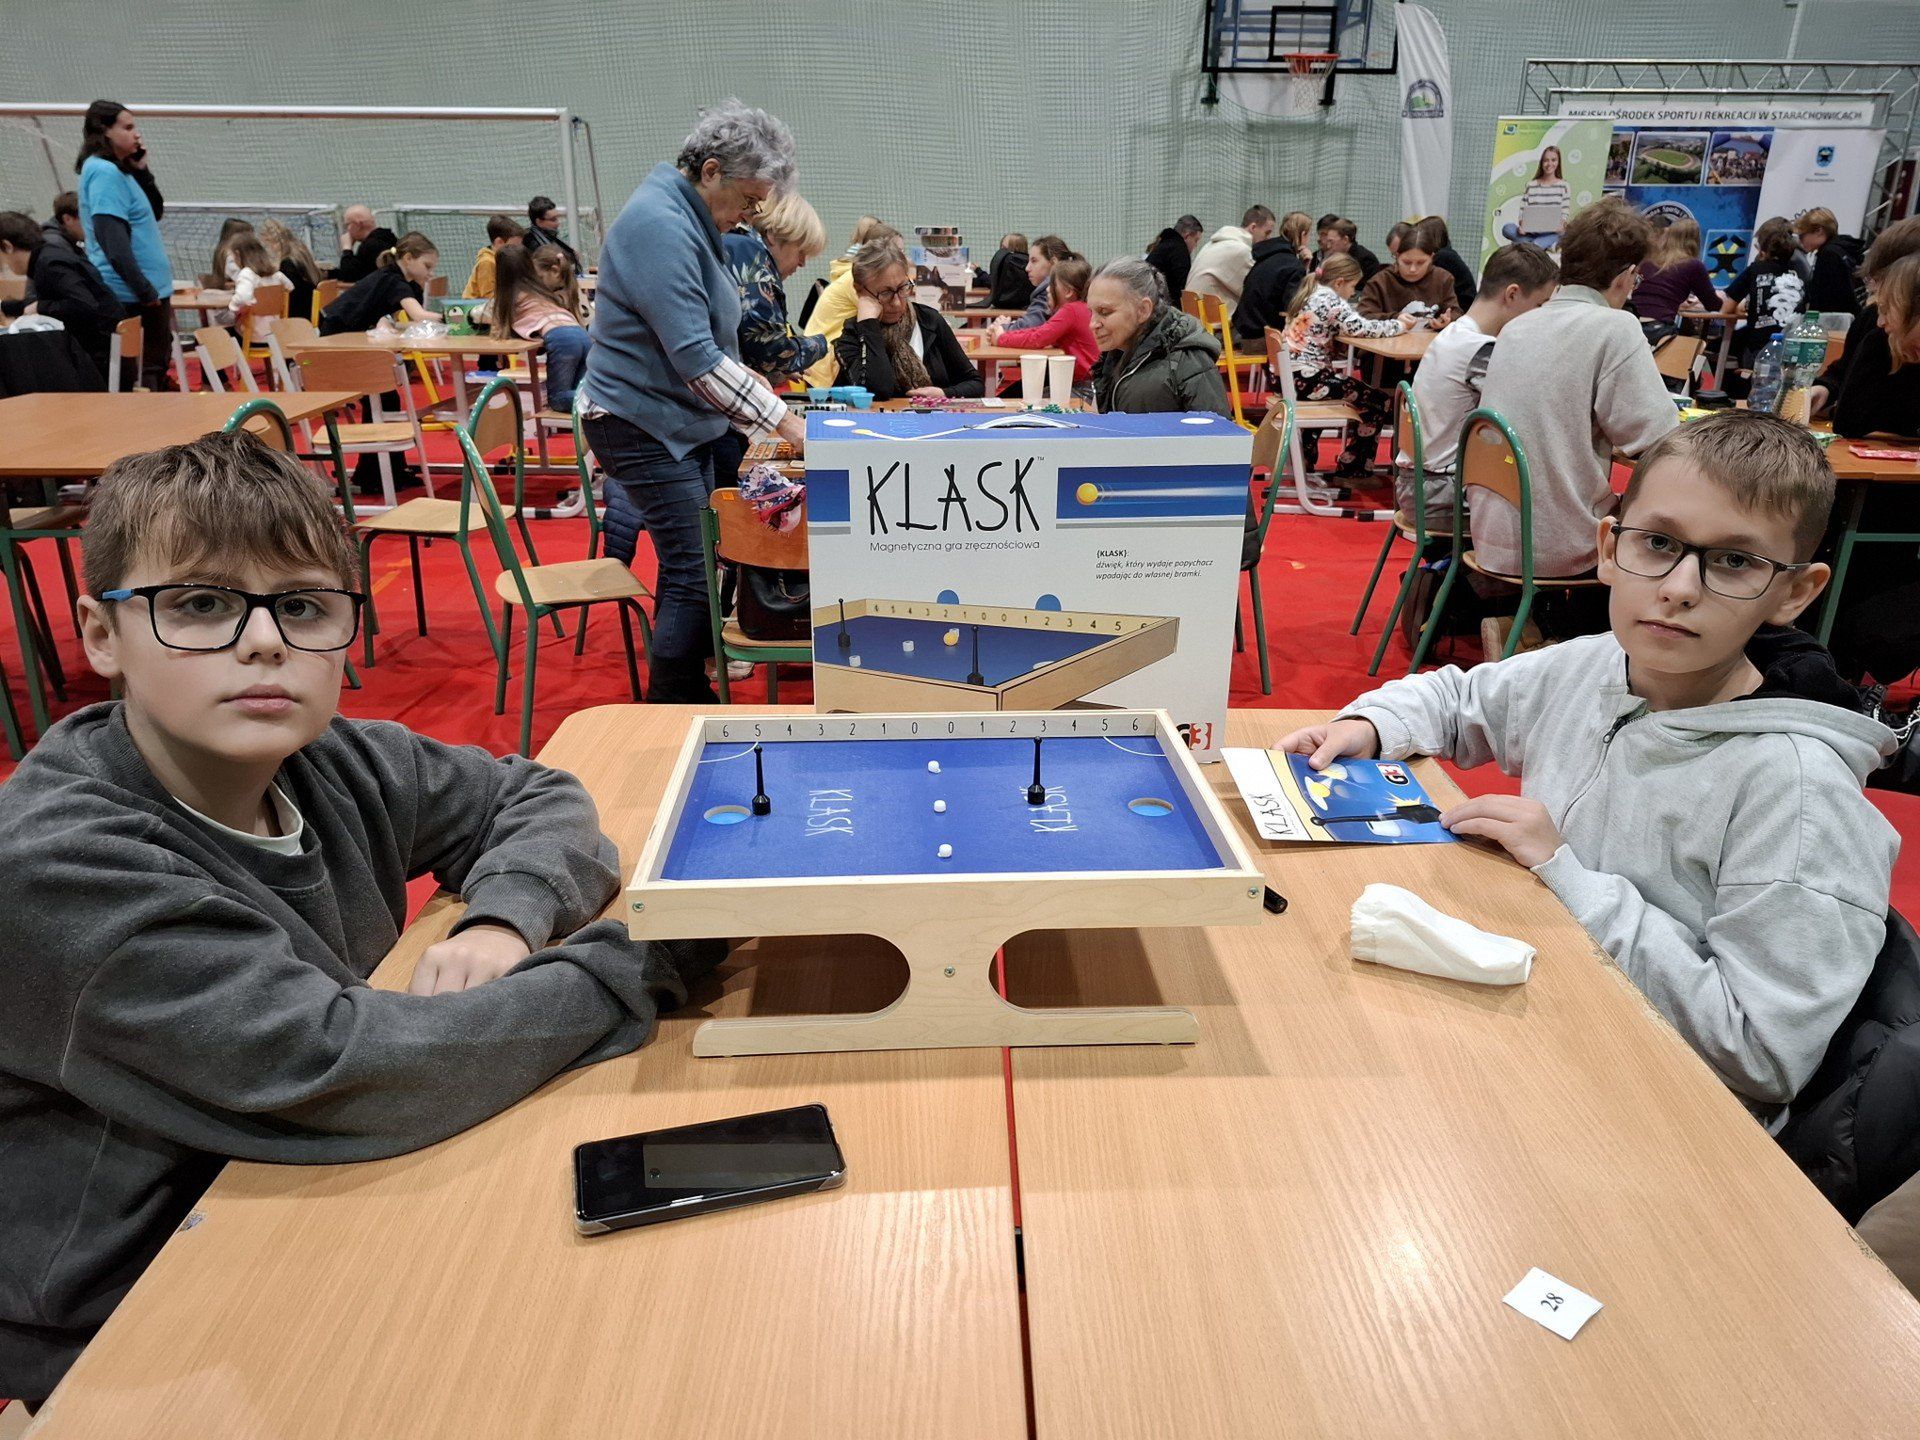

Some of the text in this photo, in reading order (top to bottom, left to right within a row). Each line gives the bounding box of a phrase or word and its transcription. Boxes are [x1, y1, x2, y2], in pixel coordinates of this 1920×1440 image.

[1658, 110, 1697, 120] SPORTU
[1704, 111, 1757, 120] REKREACJI
[1758, 111, 1768, 120] W
[1772, 111, 1862, 121] STARACHOWICACH
[867, 457, 1039, 536] KLASK
[869, 540, 1041, 553] Magnetyczna gra zręcznościowa
[1095, 569, 1203, 581] wpadając do własnej bramki.
[1096, 559, 1214, 570] dźwięk, który wydaje popychacz
[722, 724, 730, 738] 6
[754, 723, 762, 737] 5
[786, 723, 793, 736] 4
[818, 723, 825, 736] 3
[849, 722, 856, 736] 2
[911, 721, 918, 735] 0
[947, 720, 955, 734] 0
[1009, 720, 1017, 733] 2
[1041, 719, 1047, 733] 3
[1071, 719, 1077, 732] 4
[1101, 718, 1109, 732] 5
[1132, 717, 1139, 731] 6
[805, 789, 855, 837] KLASK
[1248, 793, 1294, 835] KLASK
[1540, 1292, 1565, 1313] 28
